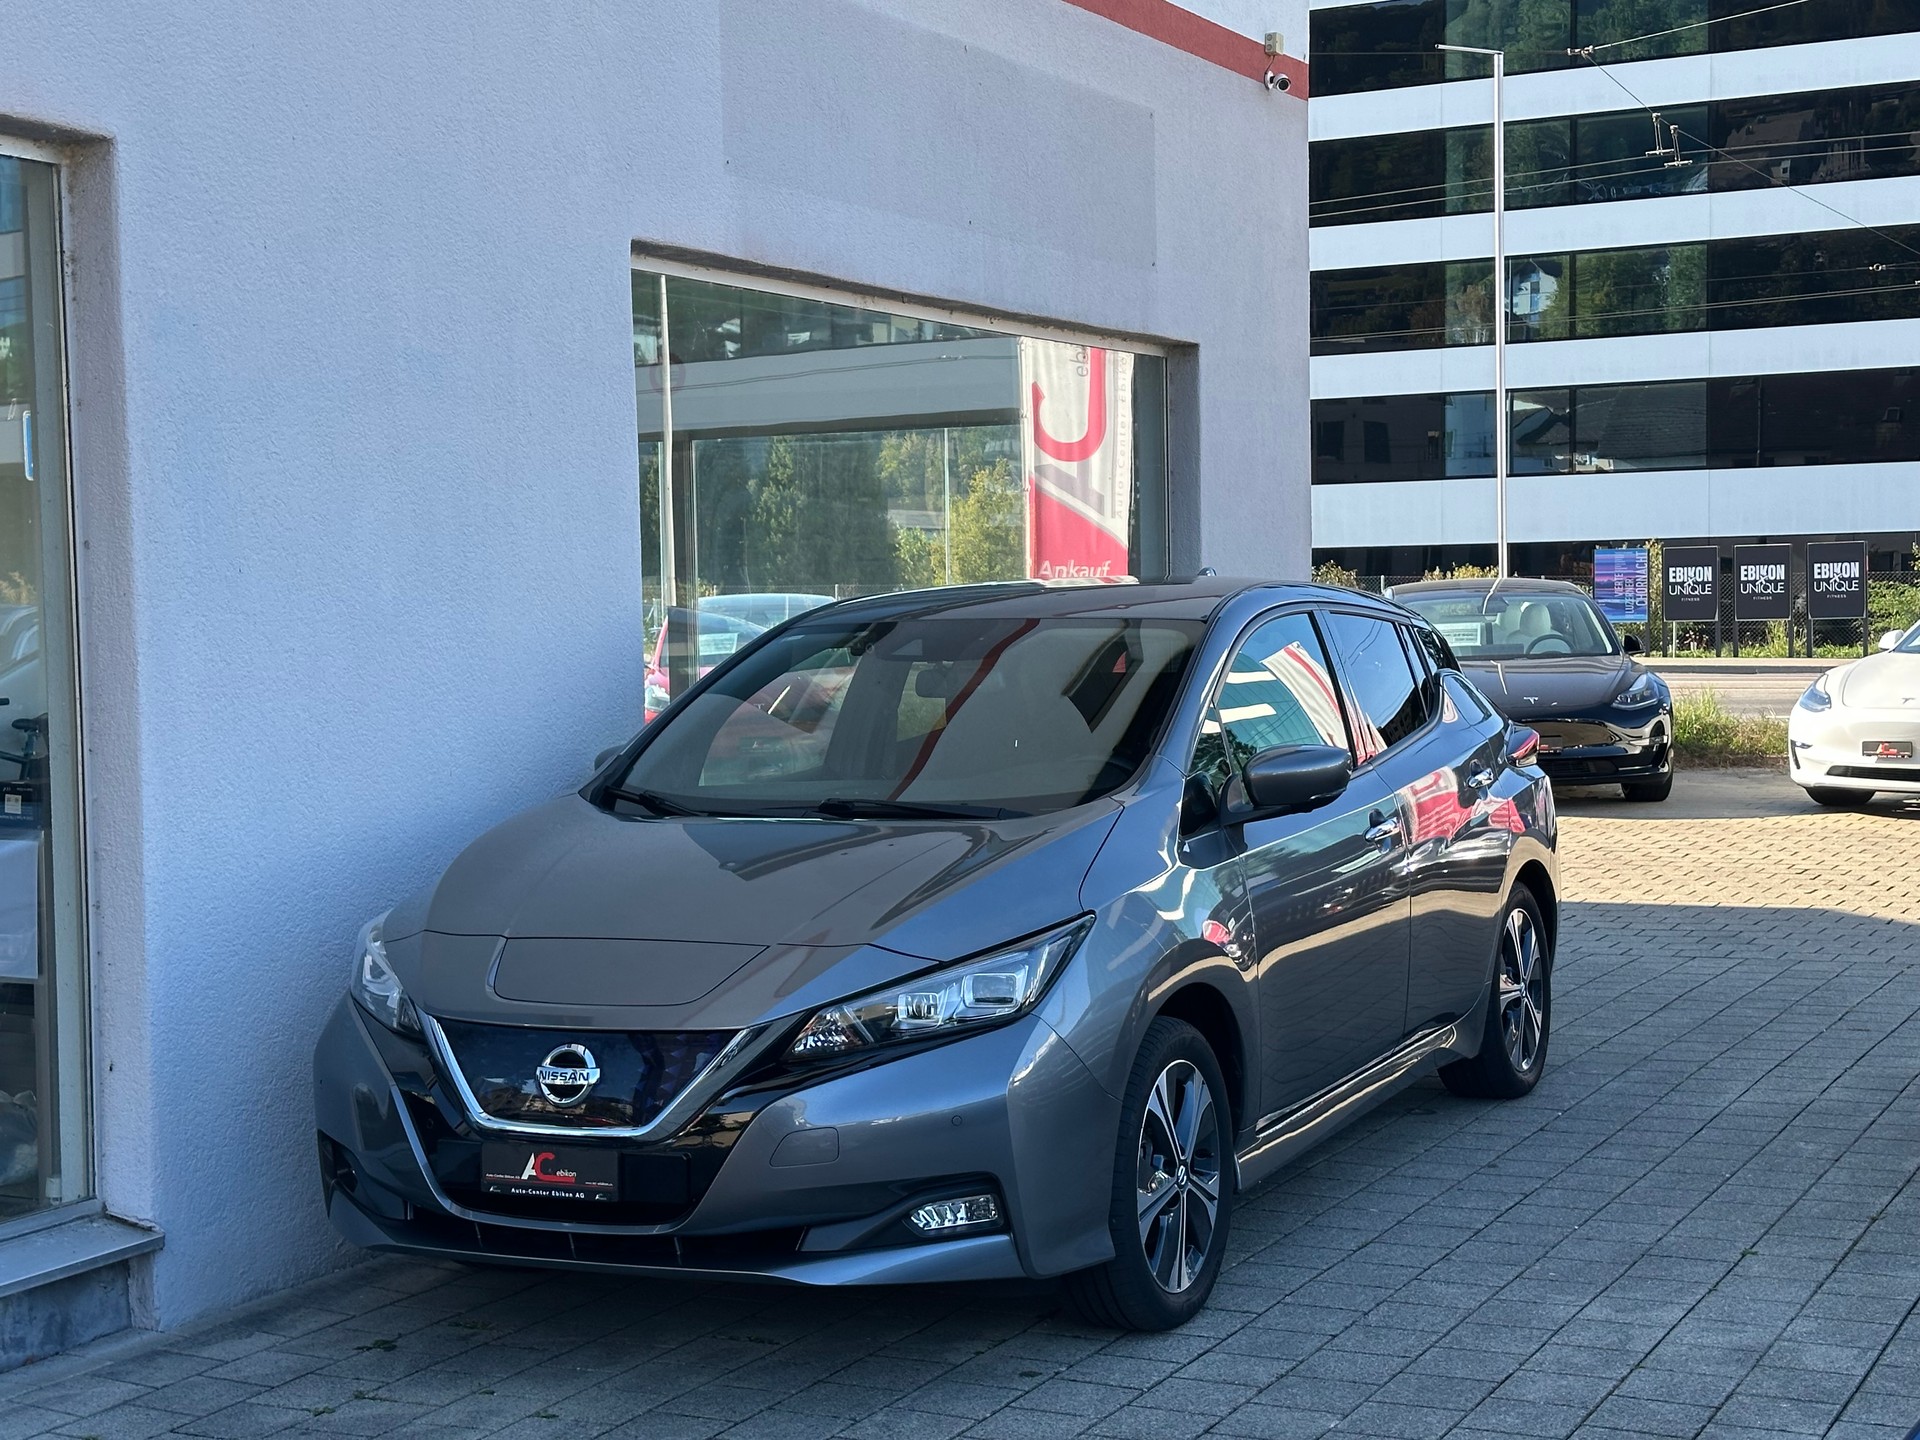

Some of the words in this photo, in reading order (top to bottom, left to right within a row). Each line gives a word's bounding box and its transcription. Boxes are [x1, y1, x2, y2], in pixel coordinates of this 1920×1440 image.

[1040, 559, 1111, 579] Ankauf
[1668, 566, 1712, 583] EBIKON
[1740, 564, 1785, 581] EBIKON
[1814, 561, 1860, 579] EBIKON
[1614, 573, 1624, 597] VIERTE
[1635, 551, 1648, 606] CHORNACHT
[1814, 580, 1860, 592] UNIQUE
[1625, 578, 1635, 614] LUZERNER
[1668, 583, 1712, 596] UNIQUE
[1740, 582, 1785, 595] UNIQUE
[538, 1070, 590, 1082] NISSAN
[511, 1187, 550, 1196] Auto-Center
